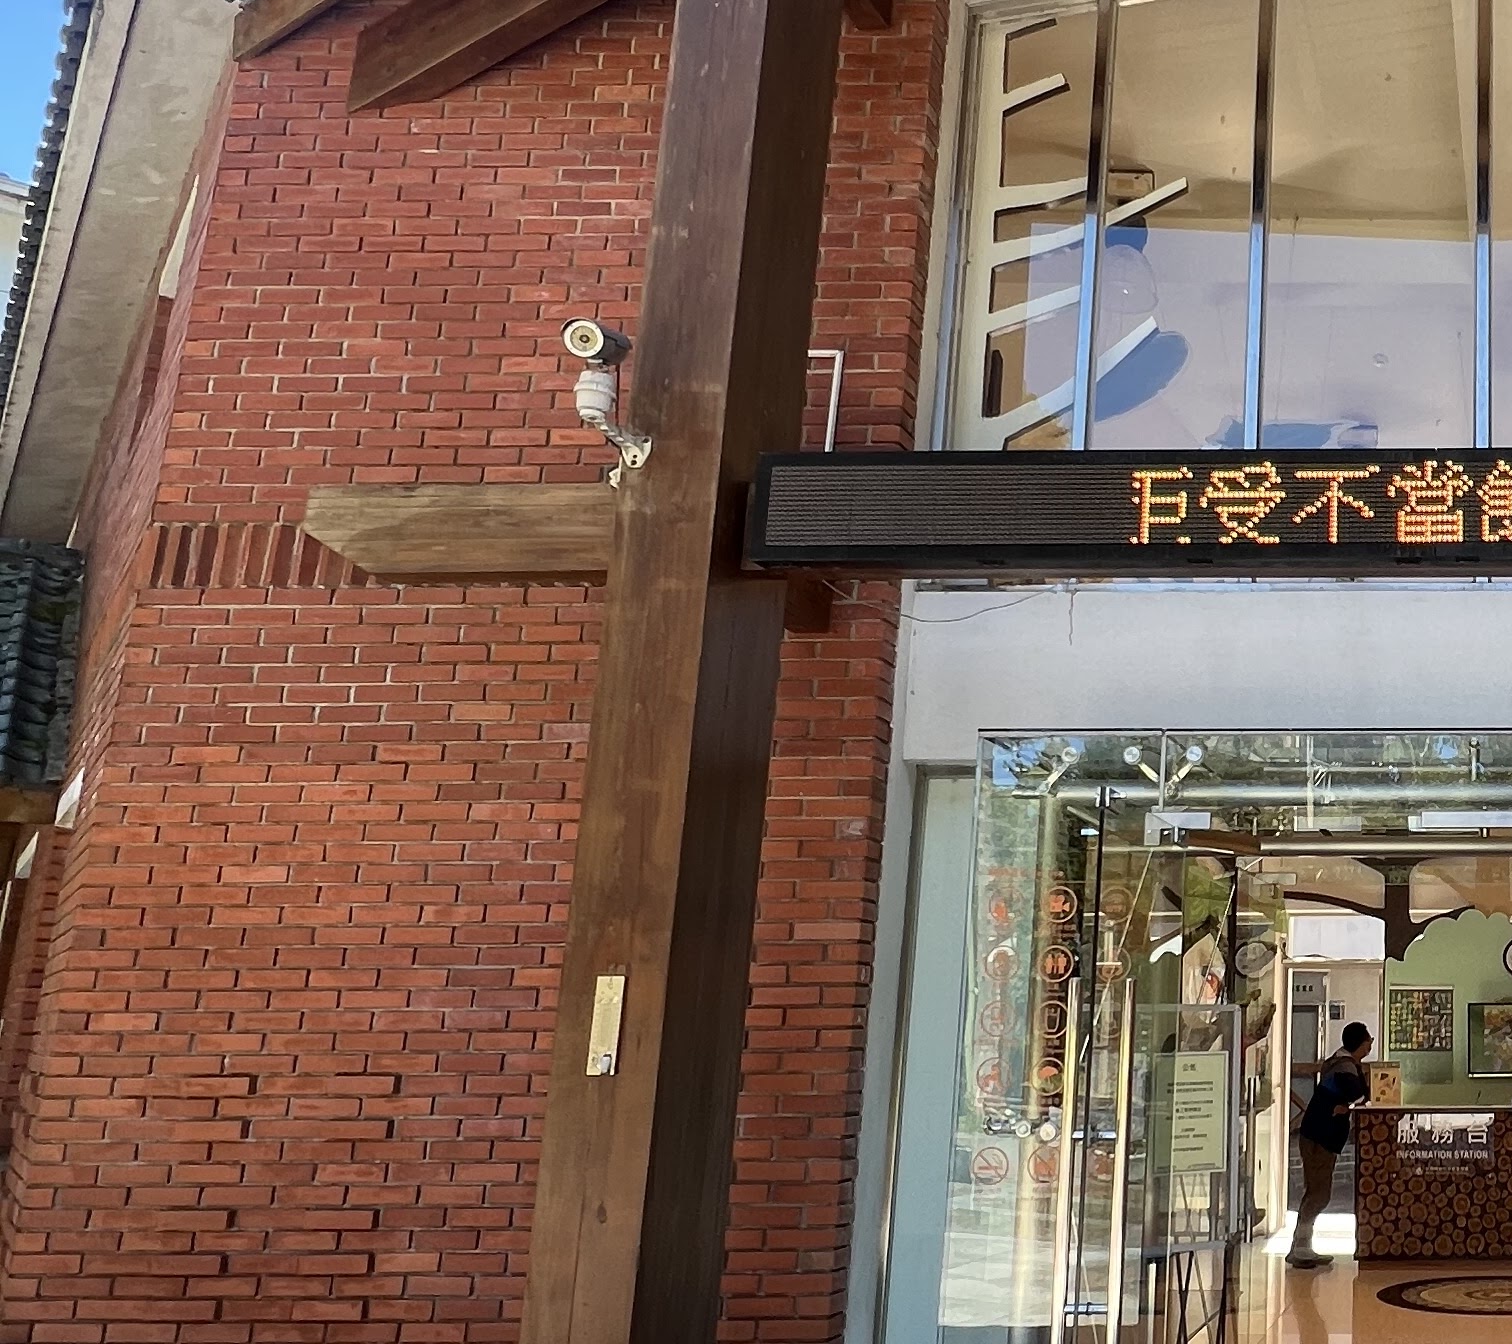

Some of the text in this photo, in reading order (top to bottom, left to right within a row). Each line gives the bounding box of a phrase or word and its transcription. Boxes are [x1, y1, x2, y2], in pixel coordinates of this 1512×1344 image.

[1397, 1119, 1489, 1144] 服務台
[1396, 1150, 1489, 1160] INFORMATION STATION
